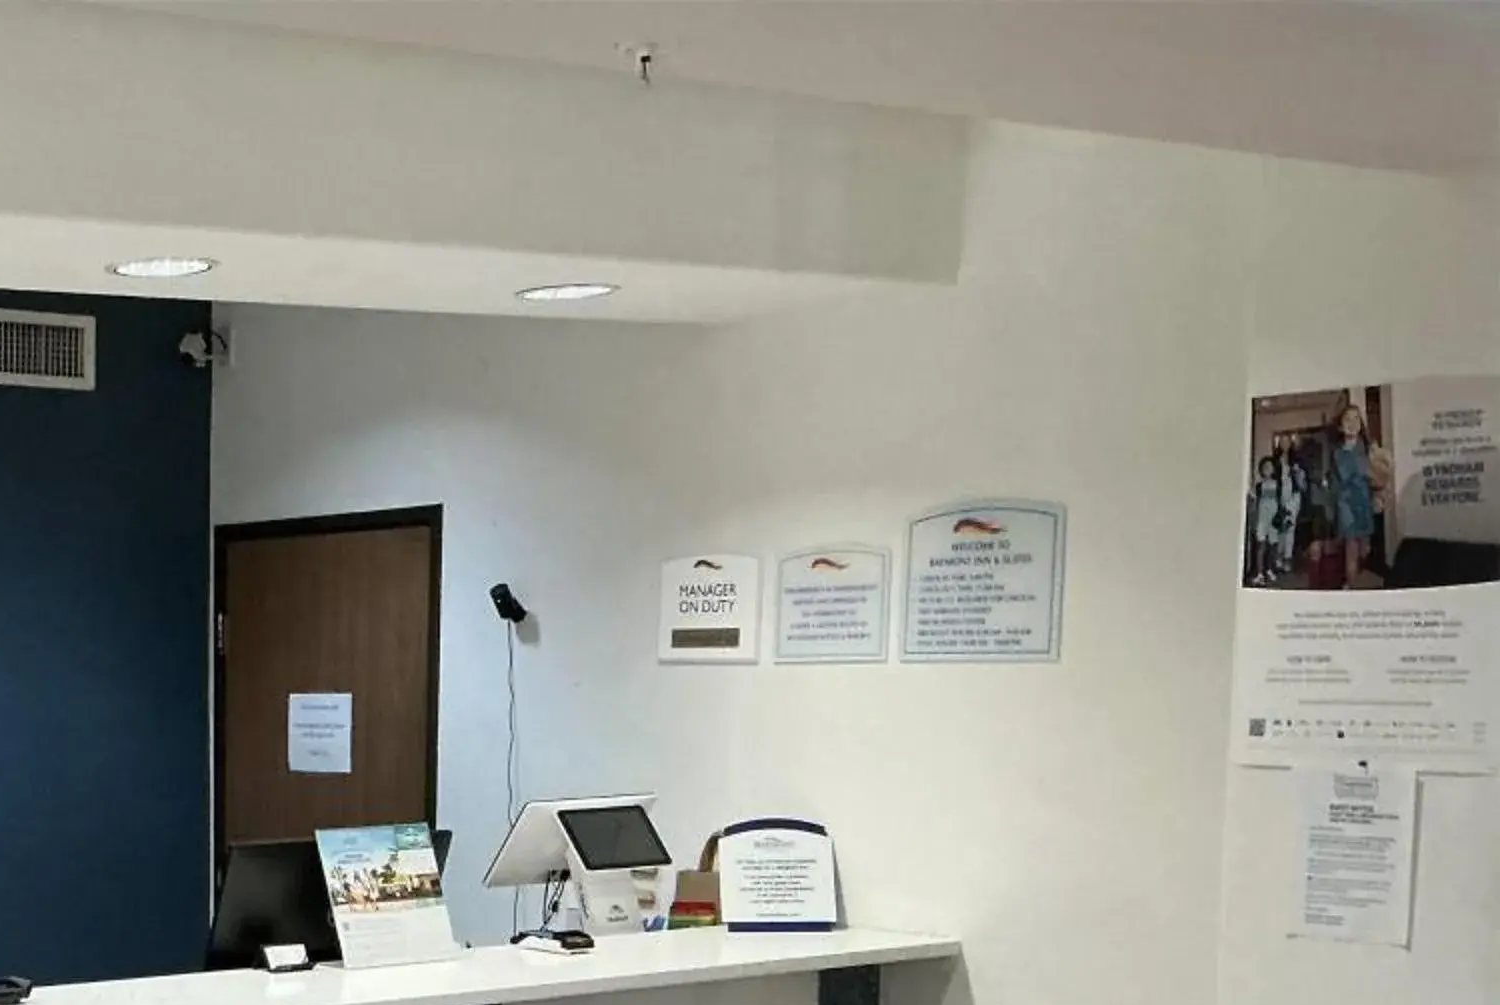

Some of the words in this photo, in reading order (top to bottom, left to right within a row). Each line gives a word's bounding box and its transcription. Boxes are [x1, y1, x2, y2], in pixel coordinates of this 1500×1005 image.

[678, 583, 737, 597] MANAGER
[678, 600, 698, 613] ON
[702, 600, 735, 613] DUTY
